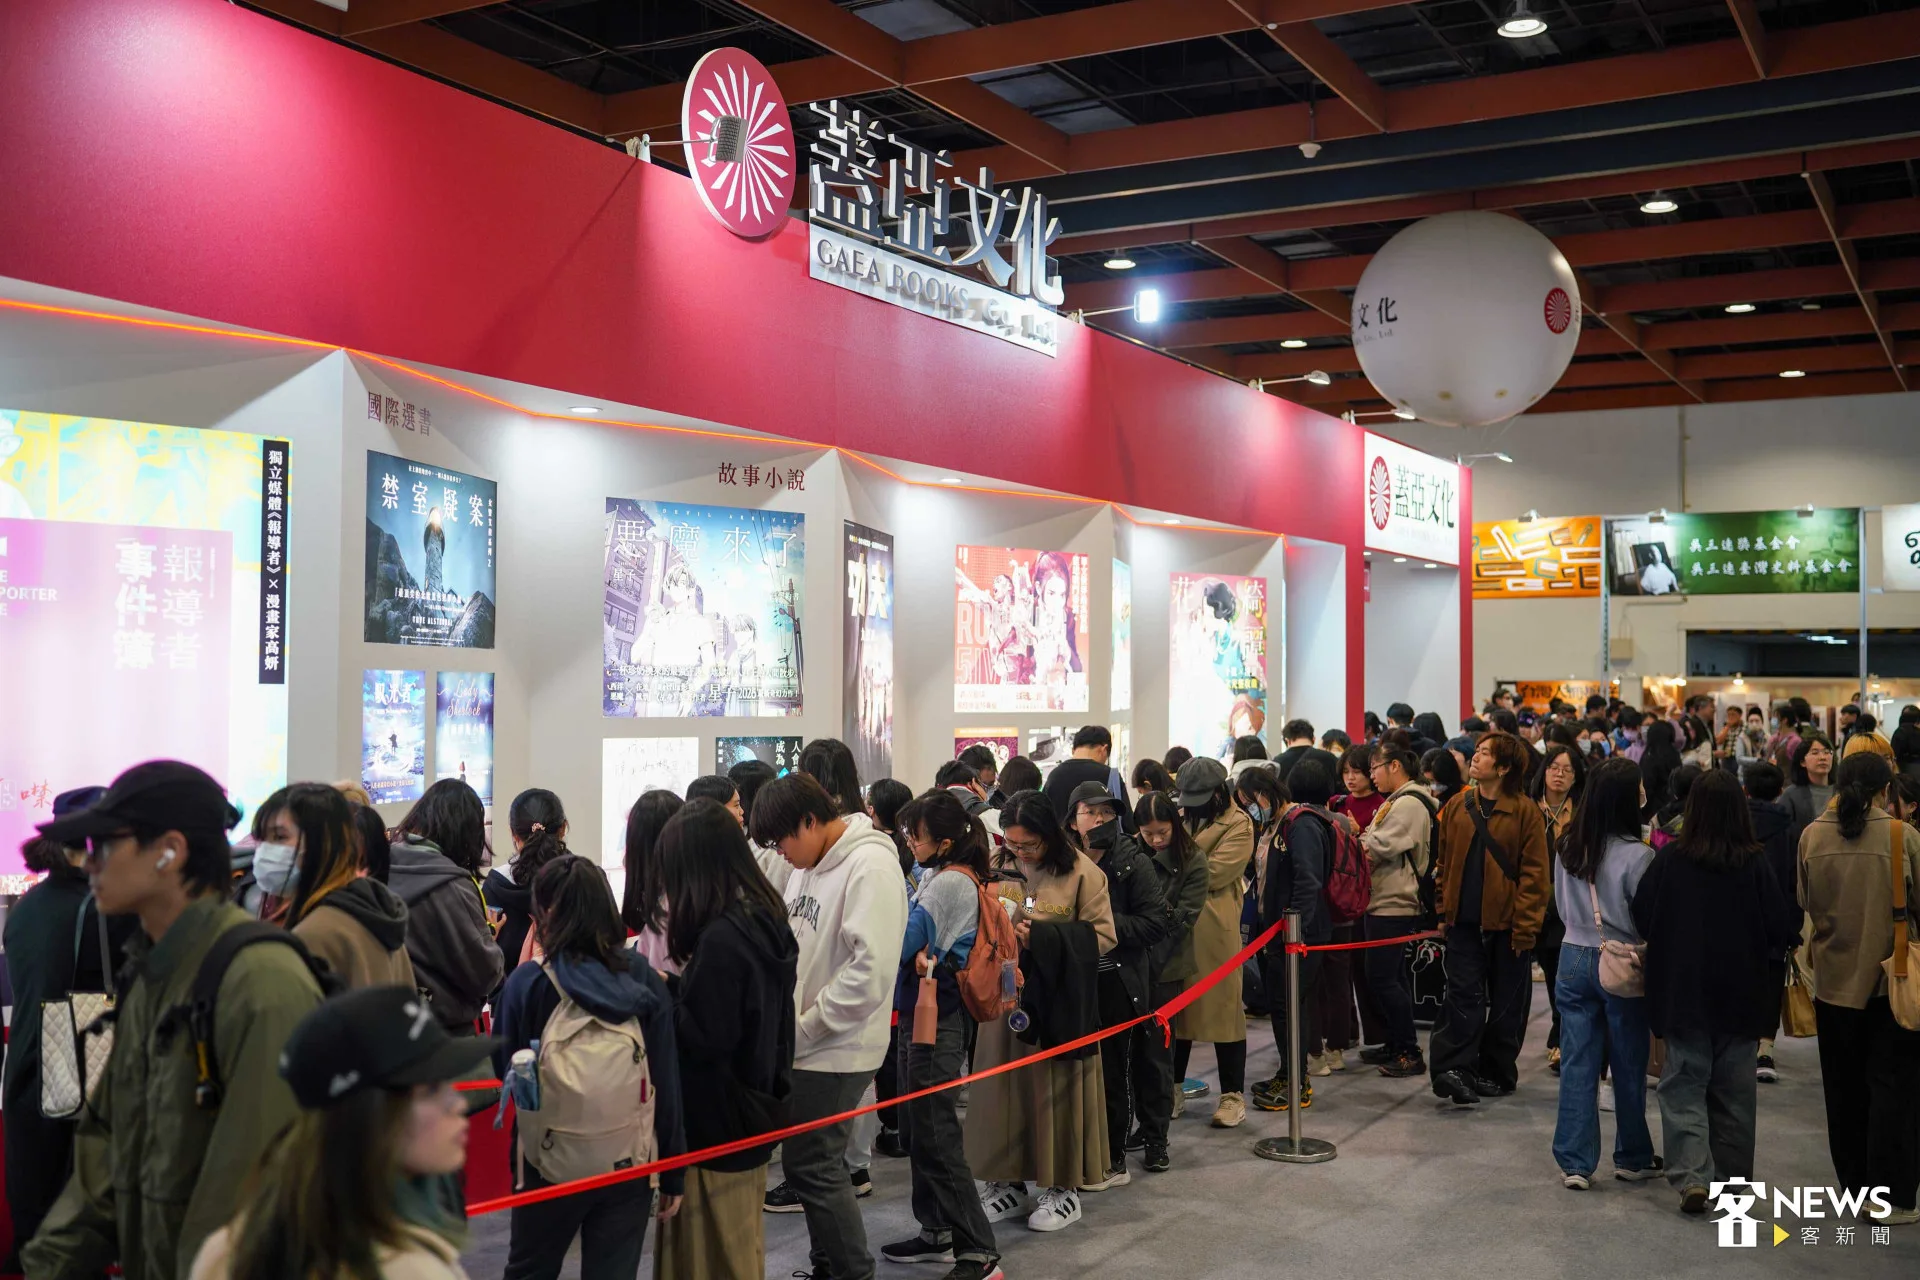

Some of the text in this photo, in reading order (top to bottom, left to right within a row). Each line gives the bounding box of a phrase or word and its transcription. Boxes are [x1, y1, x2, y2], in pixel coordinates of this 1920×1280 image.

[809, 99, 1065, 305] 蓋亞文化
[816, 238, 882, 285] GAEA
[884, 262, 969, 314] BOOKS
[1358, 297, 1398, 329] 文化
[368, 391, 431, 436] 國際選書
[381, 472, 485, 528] 禁室疑案
[718, 462, 805, 491] 故事小說
[1394, 464, 1455, 529] 蓋亞文化
[161, 544, 204, 671] 報導者
[708, 683, 736, 702] 星子
[738, 687, 757, 699] 2026
